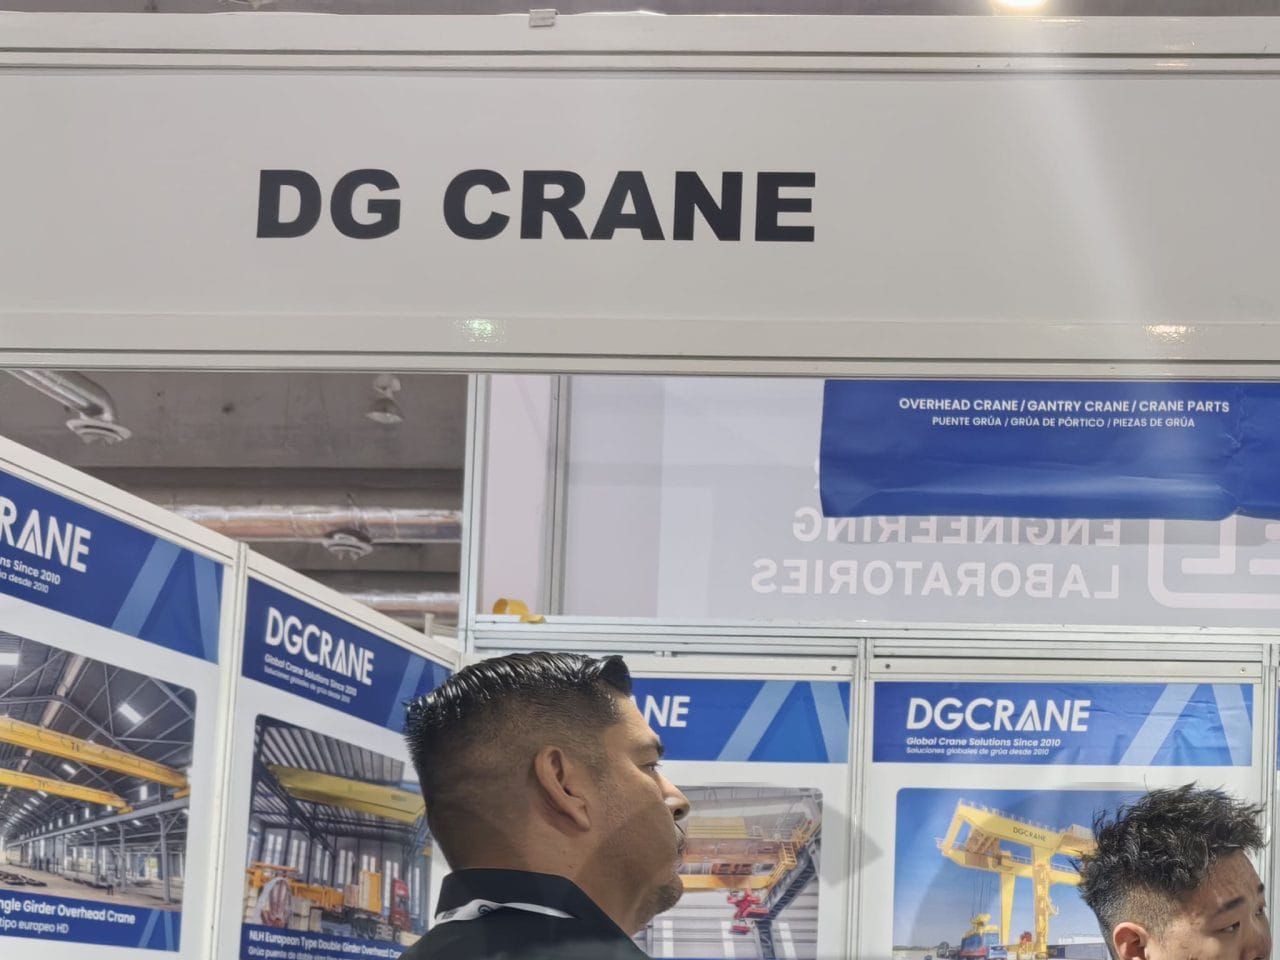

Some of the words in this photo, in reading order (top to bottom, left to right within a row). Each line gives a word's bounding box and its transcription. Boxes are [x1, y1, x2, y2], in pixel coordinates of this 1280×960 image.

[256, 168, 401, 240] DG
[442, 168, 816, 243] CRANE
[898, 397, 971, 411] OVERHEAD
[973, 399, 1019, 412] CRANE
[1027, 399, 1081, 413] GANTRY
[1084, 400, 1130, 413] CRANE
[1138, 400, 1184, 413] CRANE
[1187, 401, 1230, 413] PARTS
[932, 416, 970, 427] PUENTE
[973, 414, 1002, 427] GRÚA
[1011, 415, 1041, 427] GRÚA
[1042, 418, 1056, 427] DE
[1058, 415, 1105, 428] PÓRTICO
[1113, 418, 1148, 428] PIEZAS
[1149, 418, 1163, 428] DE
[1165, 416, 1195, 428] GRÚA
[13, 557, 39, 578] Since
[40, 566, 61, 585] 2010
[8, 573, 32, 588] desde
[33, 581, 49, 594] 2010
[265, 607, 374, 686] DGCRANE
[906, 697, 1091, 732] DGCRANE
[906, 737, 937, 746] Global
[938, 737, 967, 747] Crane
[968, 737, 1012, 747] Solutions
[1013, 738, 1038, 747] Since
[1040, 738, 1061, 748] 2010
[946, 747, 978, 756] globales
[979, 747, 988, 755] de
[1009, 748, 1032, 756] desde
[1033, 748, 1049, 756] 2010
[23, 900, 56, 915] Girder
[58, 904, 106, 921] Overhead
[107, 910, 136, 924] Crane
[18, 921, 55, 934] europeo
[56, 923, 69, 934] HD
[265, 932, 300, 948] European
[301, 936, 317, 951] Type
[318, 938, 342, 951] Double
